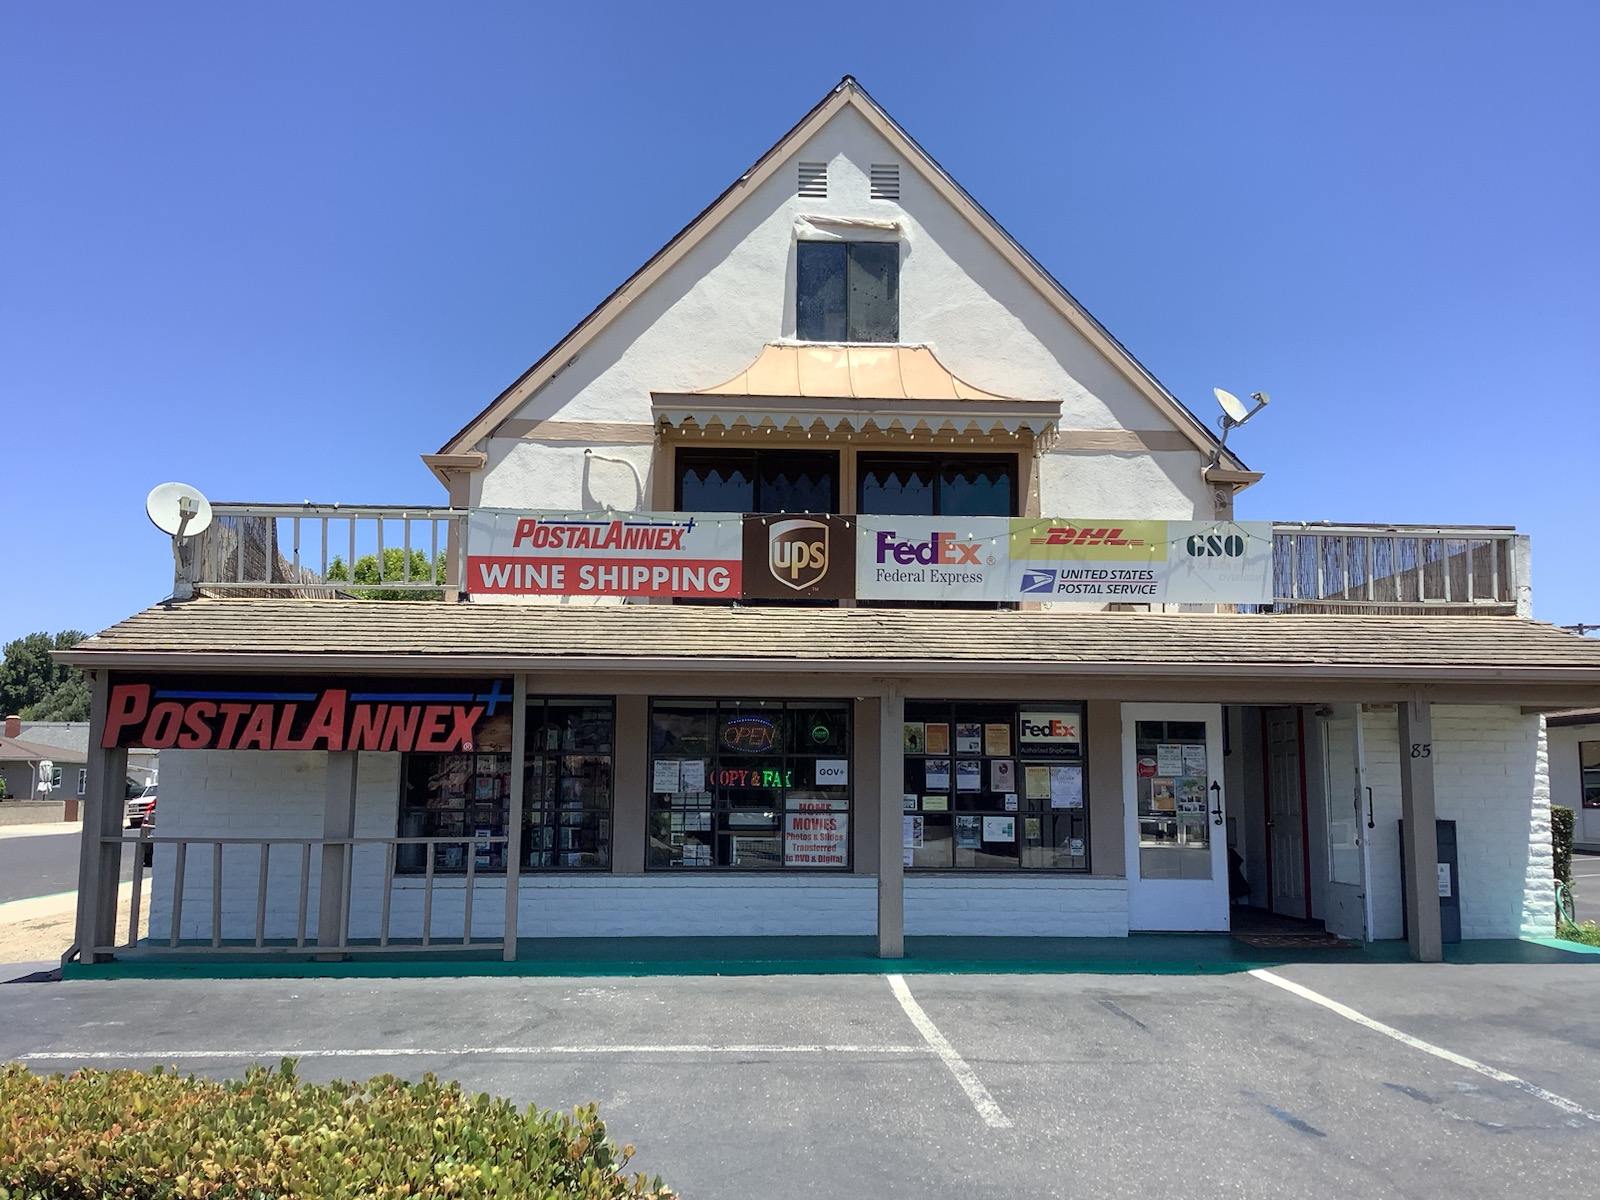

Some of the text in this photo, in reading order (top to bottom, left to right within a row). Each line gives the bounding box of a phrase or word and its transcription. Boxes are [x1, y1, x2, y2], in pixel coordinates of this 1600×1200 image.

[1045, 527, 1128, 546] DHL
[876, 531, 982, 566] FedEx
[1186, 534, 1244, 558] GSO
[479, 563, 731, 593] WINE SHIPPING
[876, 568, 983, 585] Federal Express
[1061, 569, 1154, 580] UNITED STATES
[1057, 584, 1157, 595] POSTAL SERVICE
[724, 726, 776, 746] OPEN
[1021, 719, 1076, 737] FedEx
[1411, 743, 1431, 758] 85
[751, 770, 761, 787] &
[792, 818, 837, 831] MOVIES
[786, 832, 812, 841] Photos
[792, 843, 837, 853] Transferred
[817, 855, 843, 865] Digital
